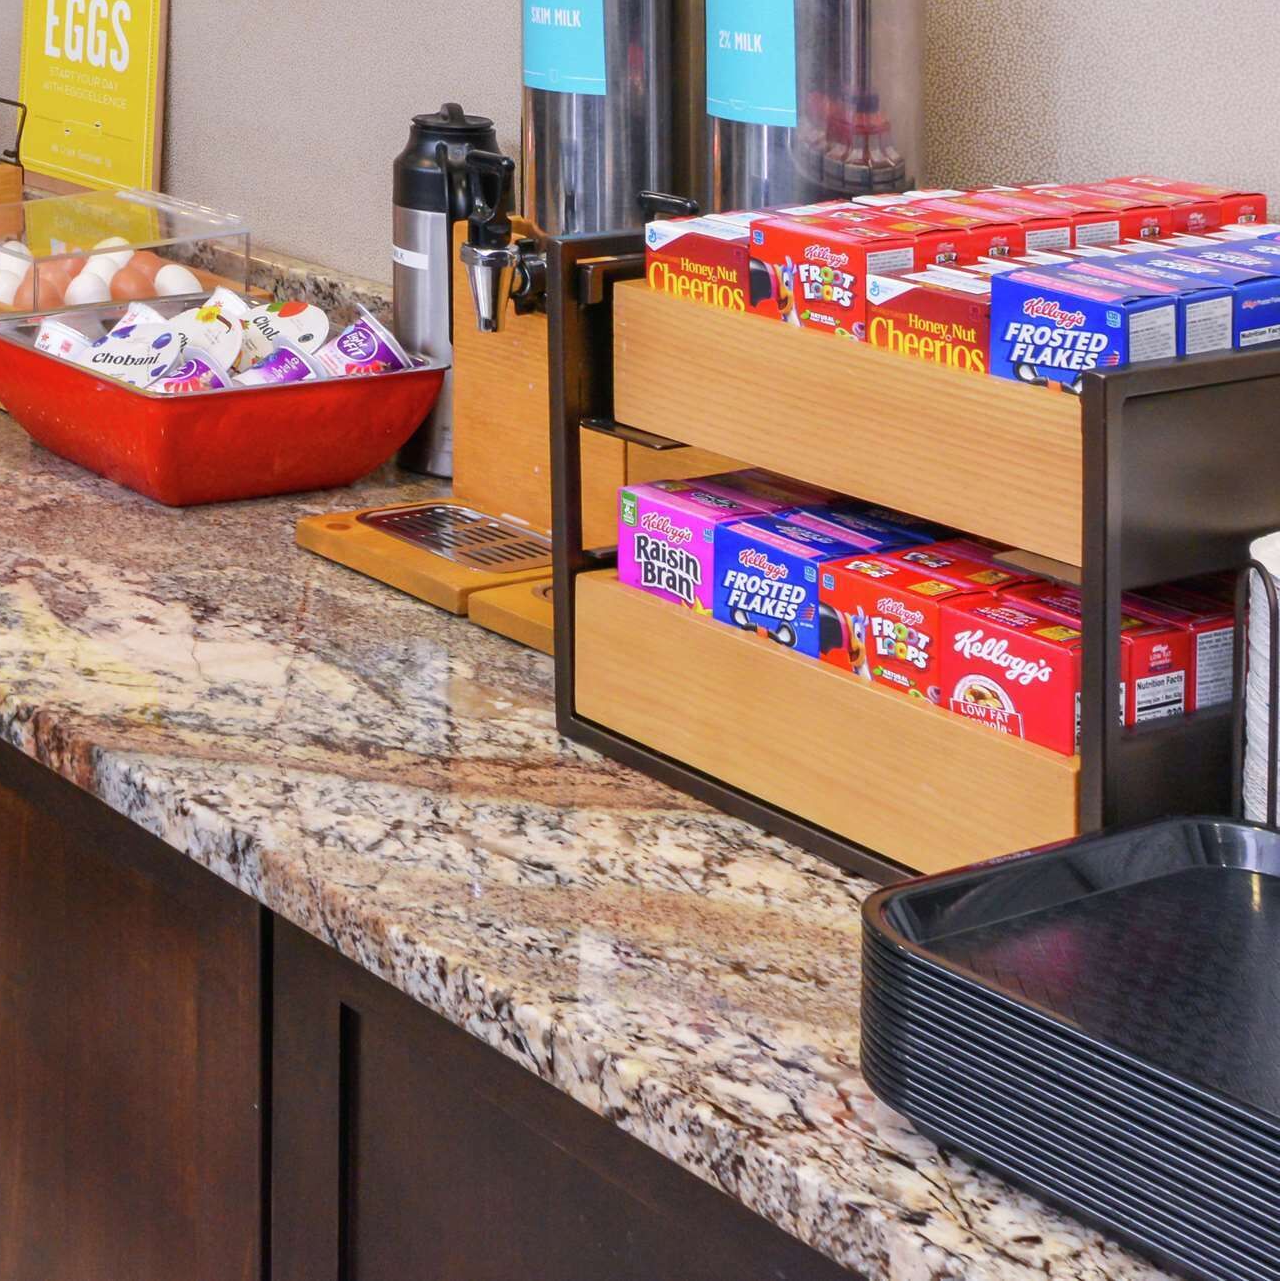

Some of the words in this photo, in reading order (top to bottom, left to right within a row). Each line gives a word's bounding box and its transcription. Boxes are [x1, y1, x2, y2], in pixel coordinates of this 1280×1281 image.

[531, 7, 551, 25] SKIM
[554, 9, 582, 28] MILK
[718, 30, 732, 50] 2%
[734, 32, 763, 53] MILK
[680, 257, 714, 280] Honey
[716, 266, 738, 283] Nut
[804, 244, 849, 268] Kellogg's
[648, 261, 745, 312] Cheerios
[799, 264, 854, 289] FROOT
[803, 282, 853, 307] LOOPS
[1023, 296, 1086, 329] Kellogg's
[908, 313, 949, 339] Honey
[952, 323, 977, 344] Nut
[1004, 322, 1109, 353] FROSTED
[92, 352, 160, 366] Chobani
[870, 316, 986, 375] Cheerios
[1010, 343, 1099, 371] FLAKES
[642, 512, 692, 543] Kellogg's
[635, 534, 702, 585] Raisin
[739, 548, 789, 580] Kellogg's
[643, 559, 695, 604] Bran
[724, 569, 807, 604] FROSTED
[727, 589, 799, 622] FLAKES
[877, 598, 925, 626] Kellogg's
[871, 617, 930, 650] FROOT
[876, 637, 930, 669] LOOPS
[953, 629, 1053, 686] Kellogg's
[1137, 679, 1165, 691] Nutrition
[1166, 675, 1183, 687] Facts
[960, 702, 987, 719] LOW
[991, 708, 1010, 723] FAT
